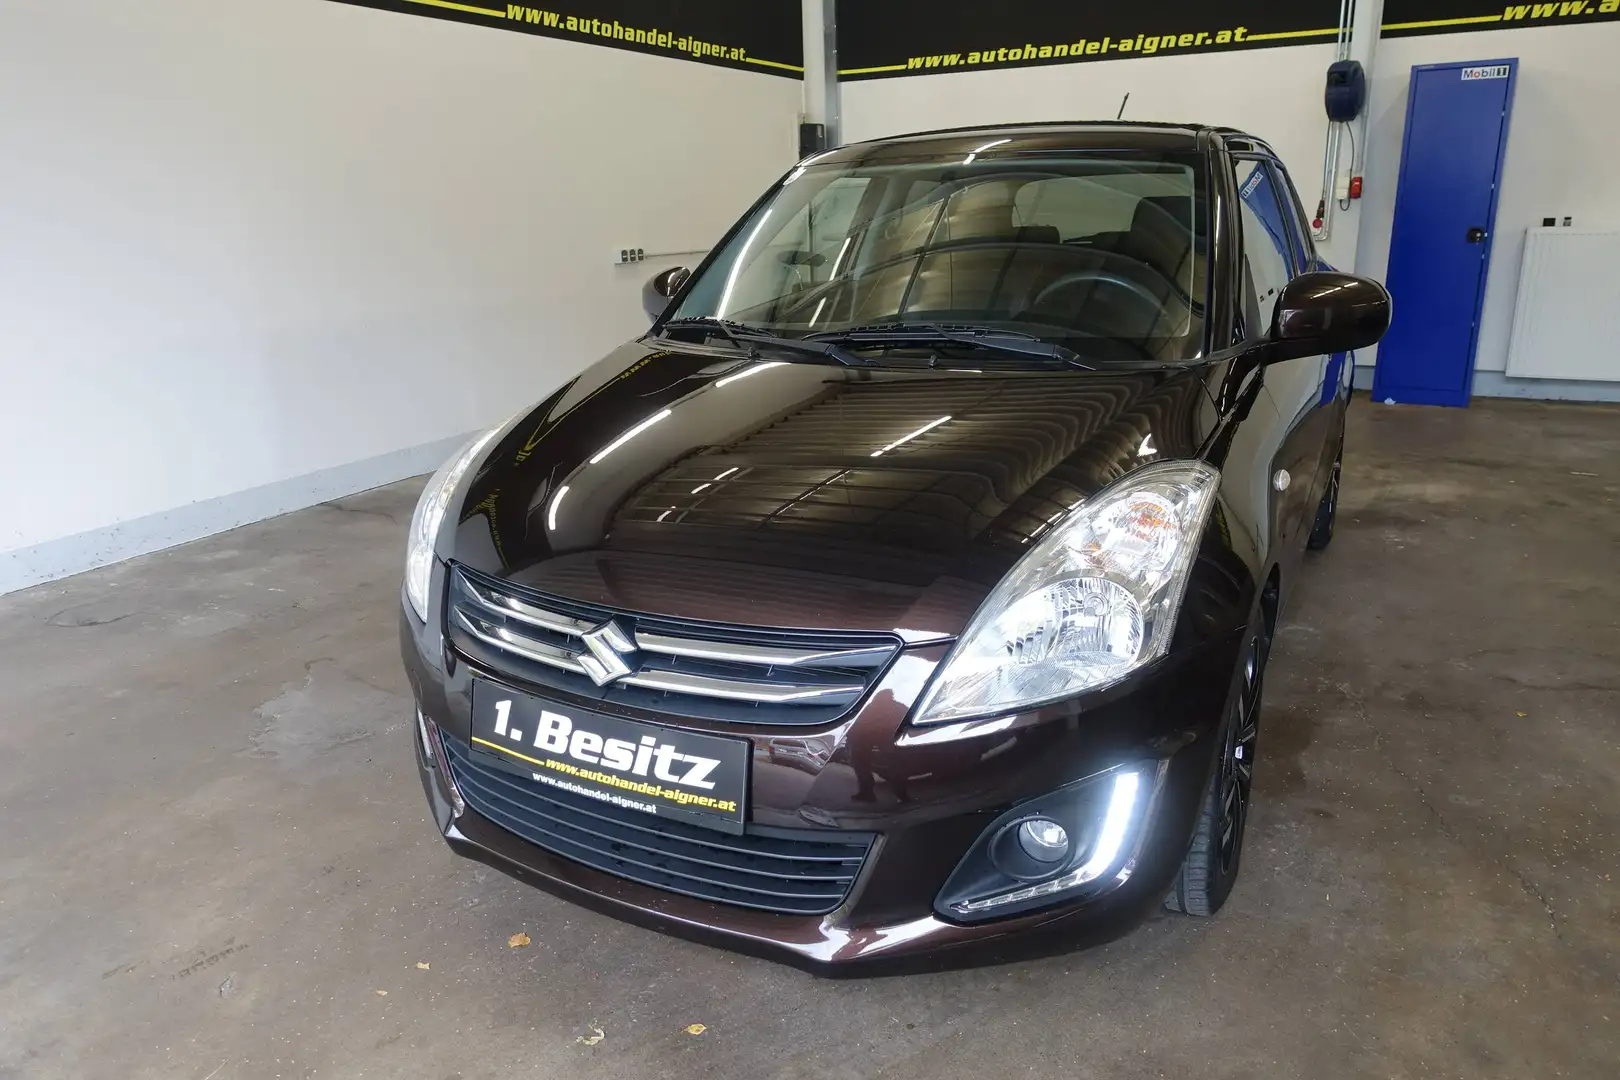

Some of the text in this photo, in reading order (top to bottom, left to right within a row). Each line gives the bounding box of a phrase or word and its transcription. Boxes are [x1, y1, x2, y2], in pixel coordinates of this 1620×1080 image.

[507, 3, 746, 62] www.autohandel-aigner.at
[907, 26, 1248, 70] www.autohandel-aigner.at
[1463, 68, 1496, 79] Mobil
[494, 699, 722, 790] 1. Besitz
[532, 771, 657, 814] www.autohandel-aigner.at
[546, 759, 737, 813] www.autohandel-aigner.at
